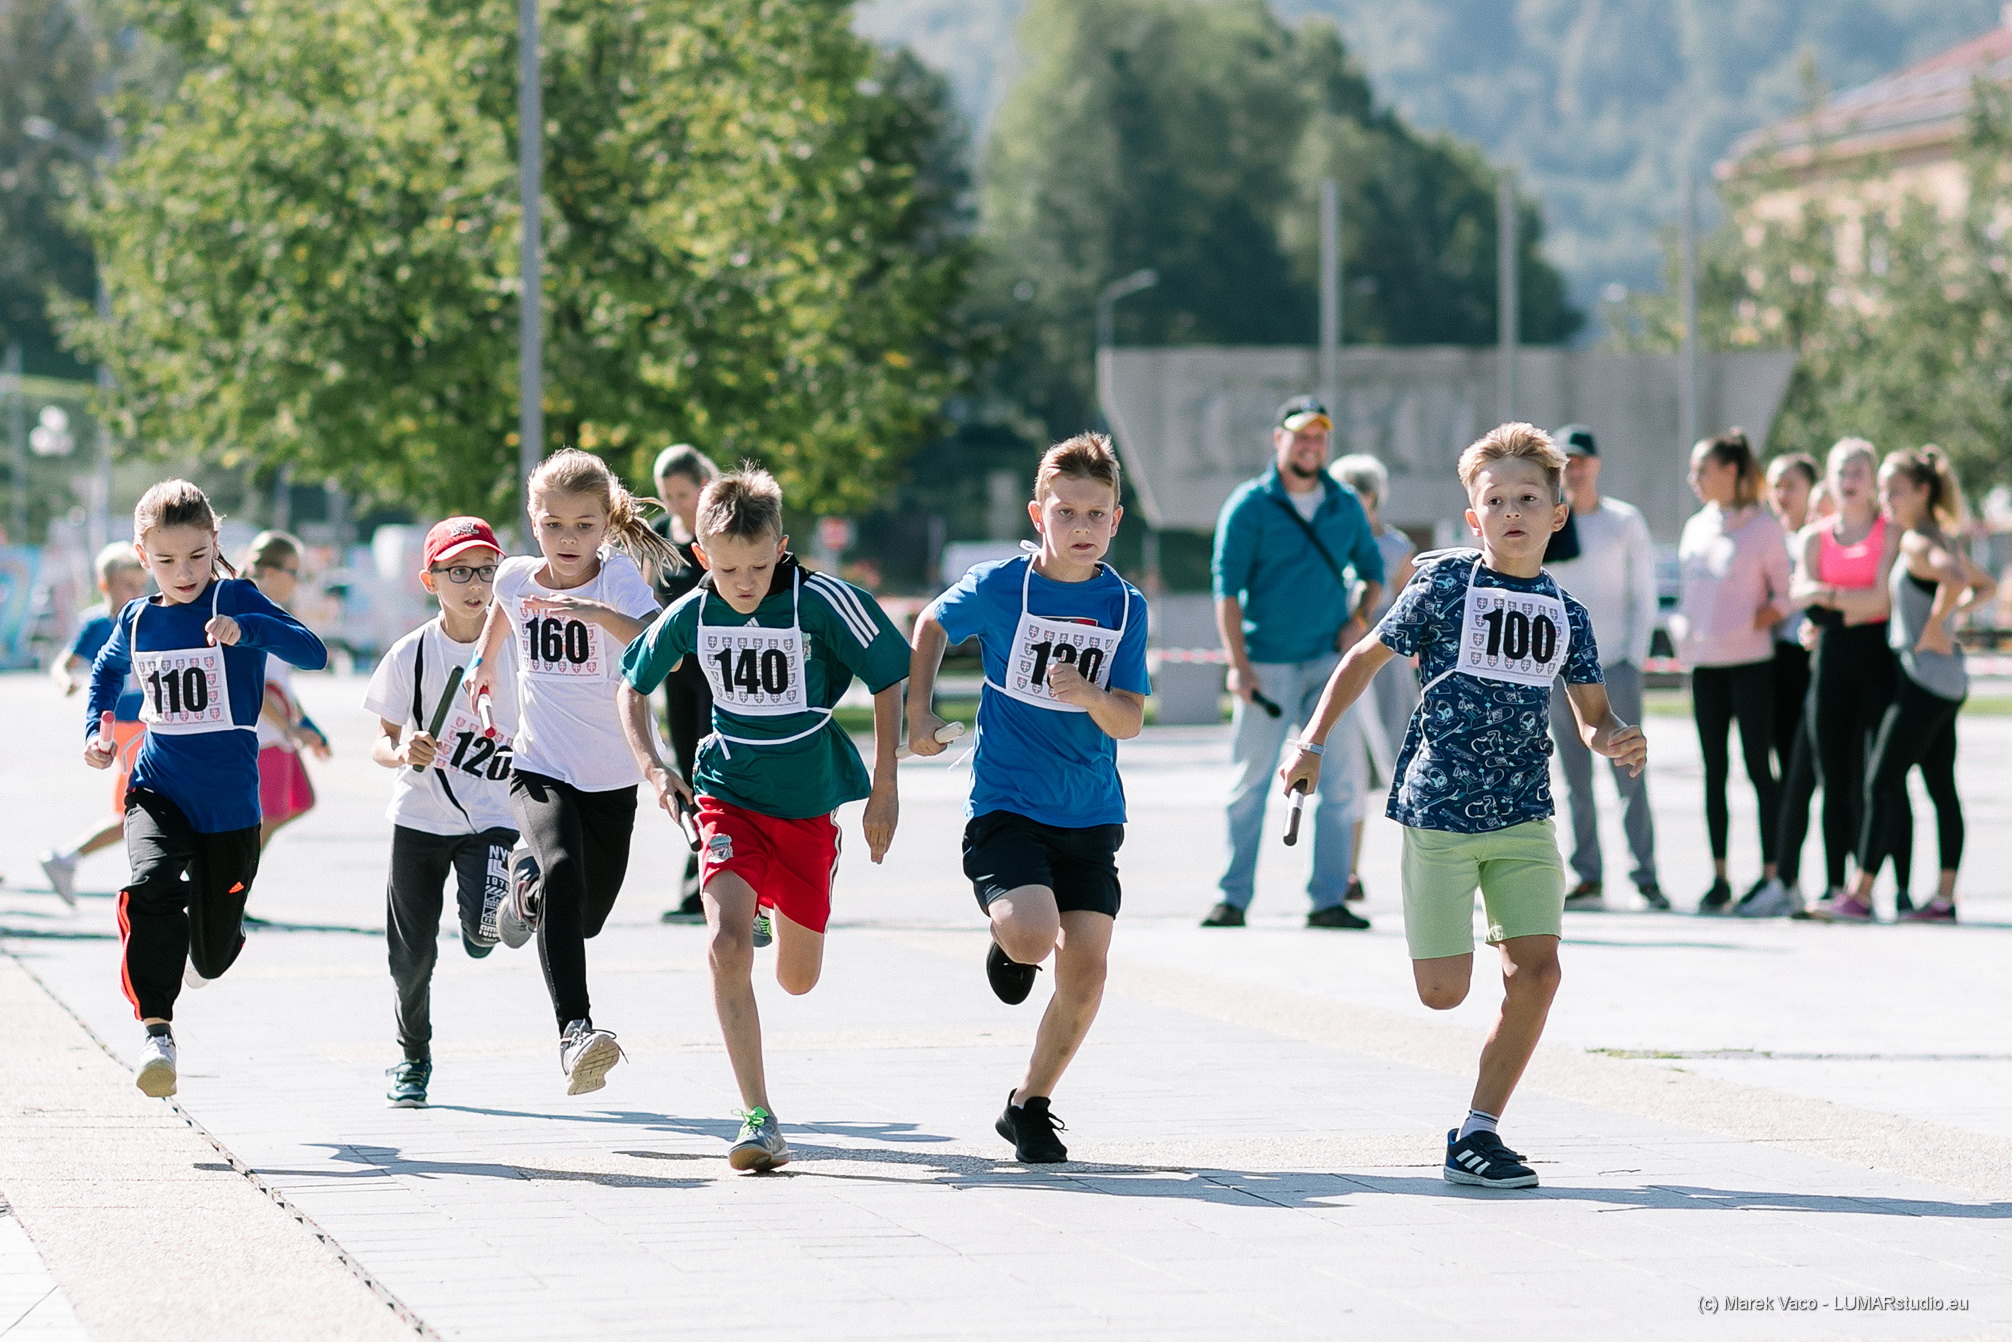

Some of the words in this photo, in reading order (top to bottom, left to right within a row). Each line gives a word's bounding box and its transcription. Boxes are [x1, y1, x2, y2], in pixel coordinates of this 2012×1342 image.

[526, 617, 589, 664] 160
[1482, 608, 1557, 664] 100
[147, 667, 208, 714] 110
[713, 648, 789, 695] 140
[450, 731, 513, 780] 120
